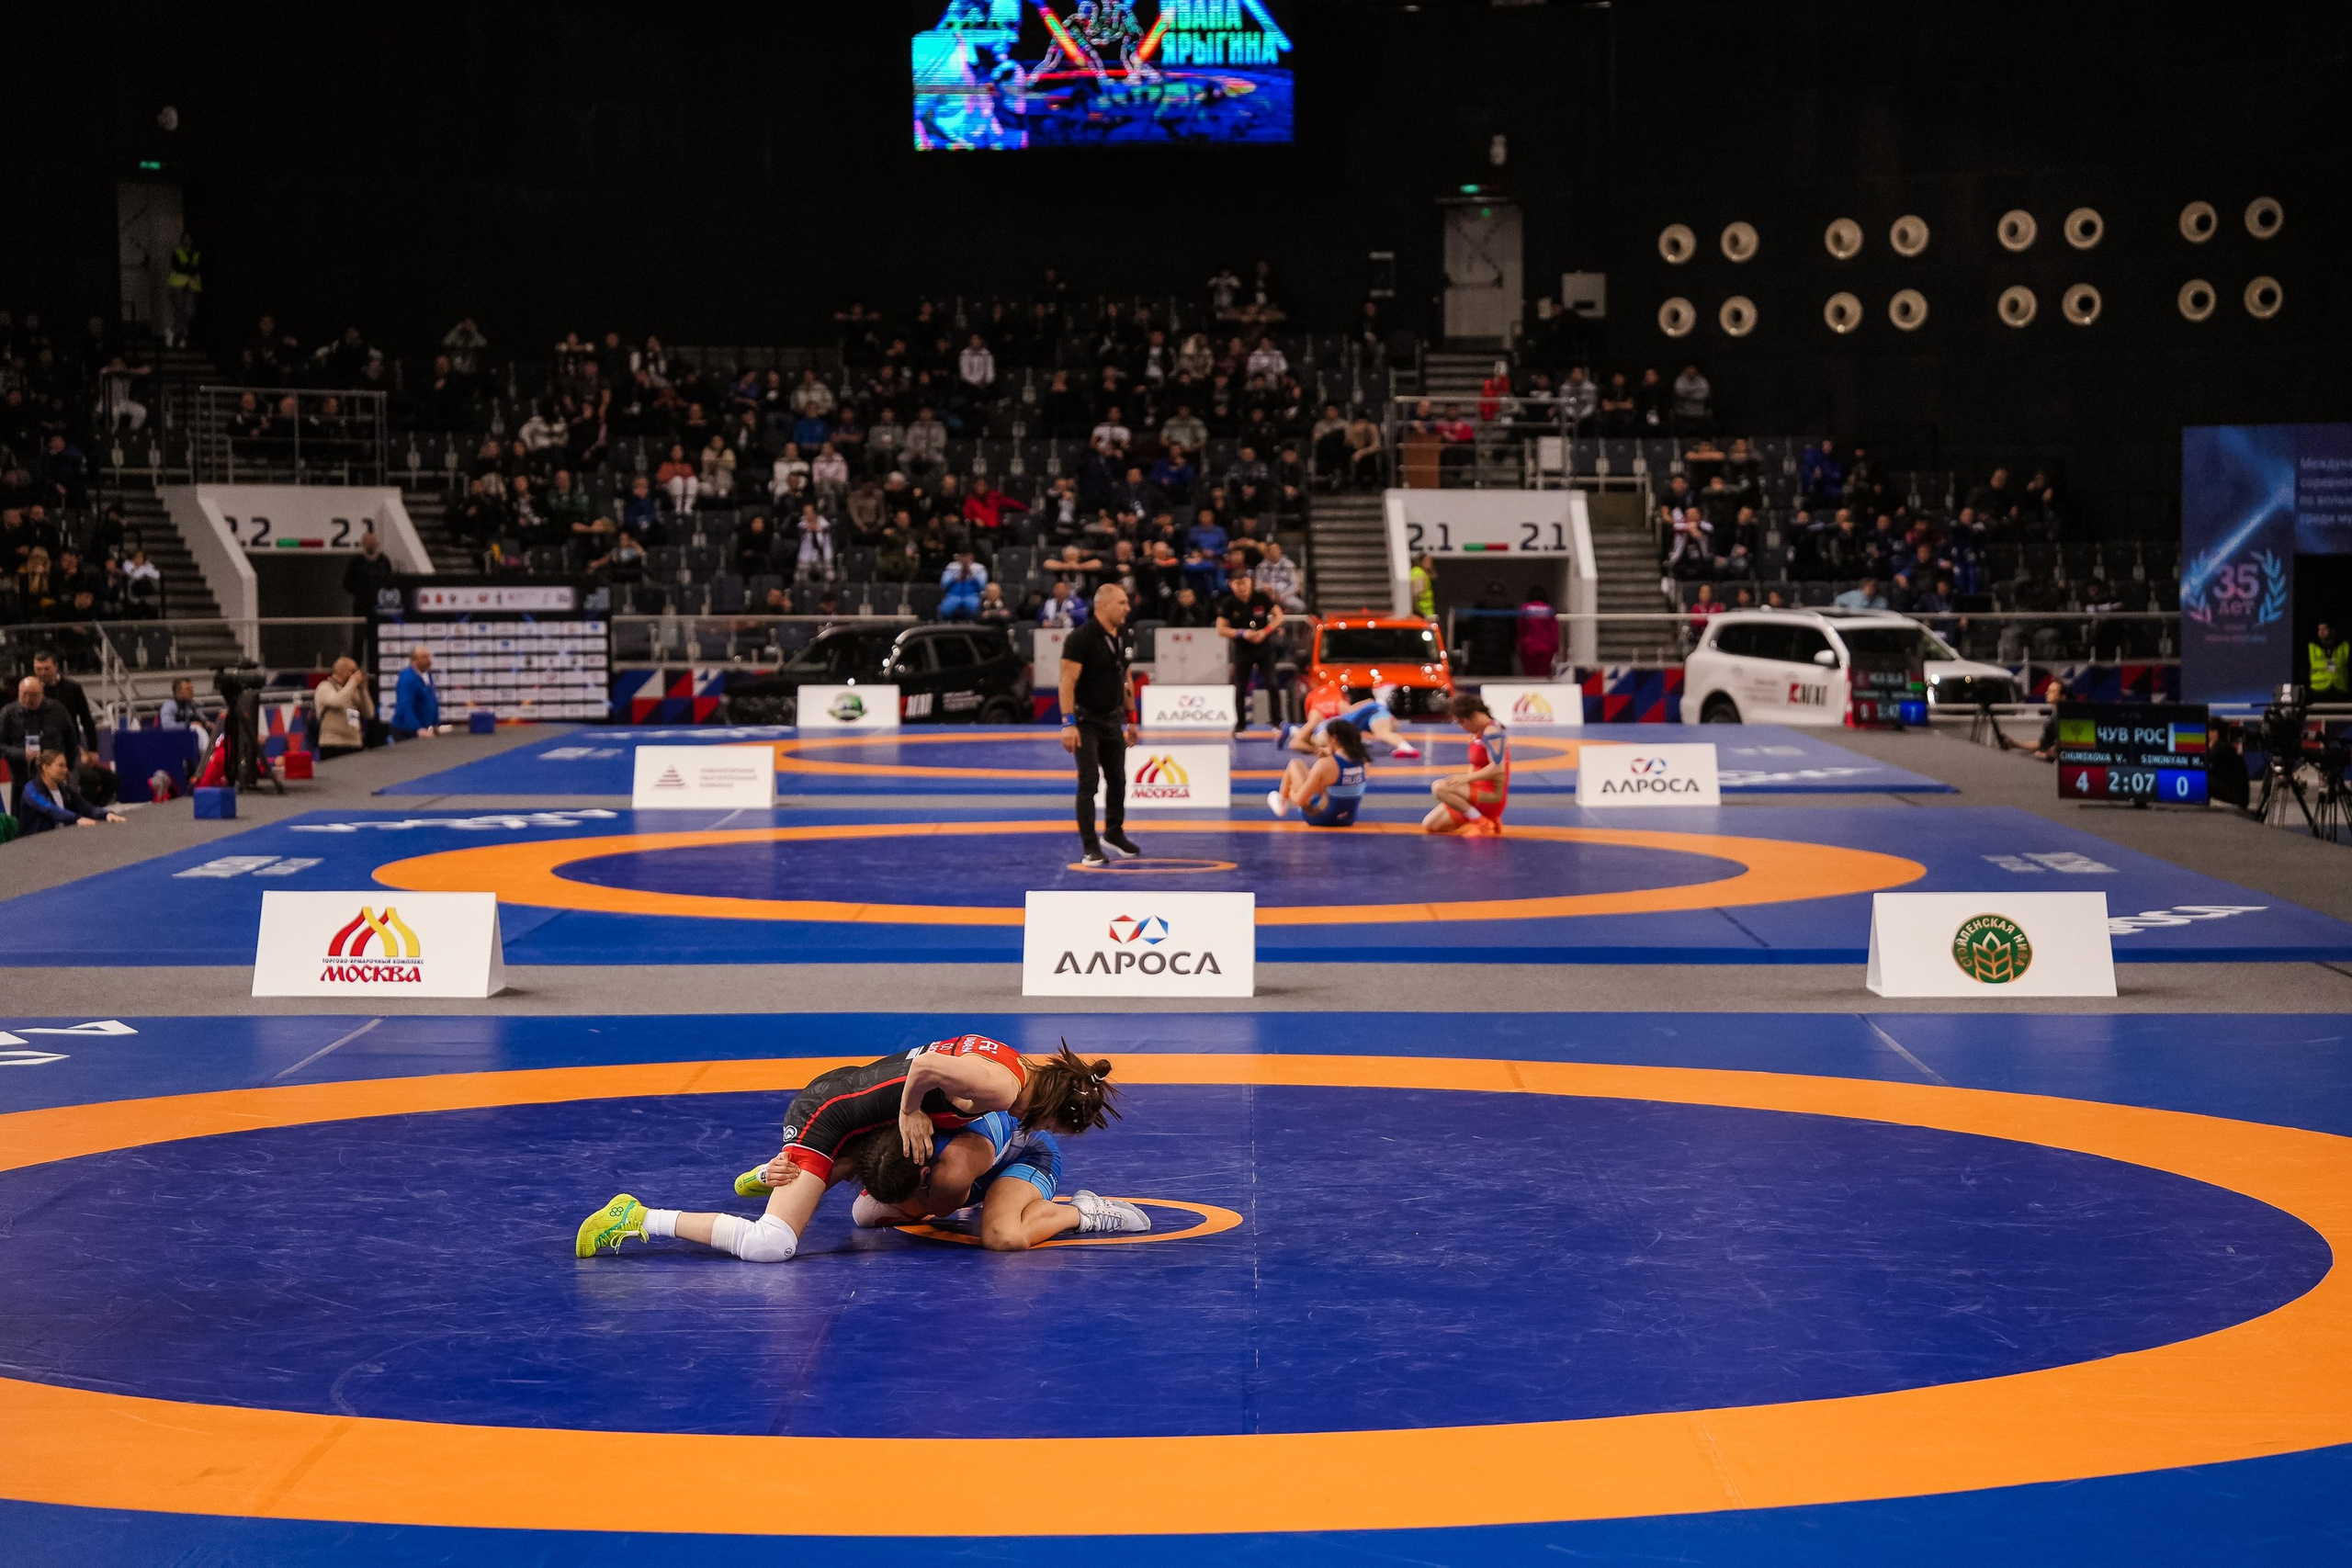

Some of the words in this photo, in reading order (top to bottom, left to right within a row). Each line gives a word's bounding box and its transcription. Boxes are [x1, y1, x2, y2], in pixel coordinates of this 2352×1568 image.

[1161, 31, 1279, 65] ЯРЫГИНА
[1407, 522, 1453, 550] 2.1
[1521, 522, 1566, 550] 2.1
[2212, 563, 2260, 600] 35
[2097, 726, 2129, 744] ЧУВ
[2134, 727, 2166, 746] РОС
[1131, 787, 1191, 799] МОСКВА
[1600, 779, 1700, 794] АЛРОСА
[2075, 770, 2090, 794] 4
[2108, 771, 2156, 794] 2:07
[2176, 775, 2189, 797] 0
[1955, 917, 2016, 968] СТОЙЛЕНСКАЯ
[2012, 933, 2029, 967] НИВА
[320, 964, 422, 983] МОСКВА
[1054, 951, 1222, 976] АЛРОСА
